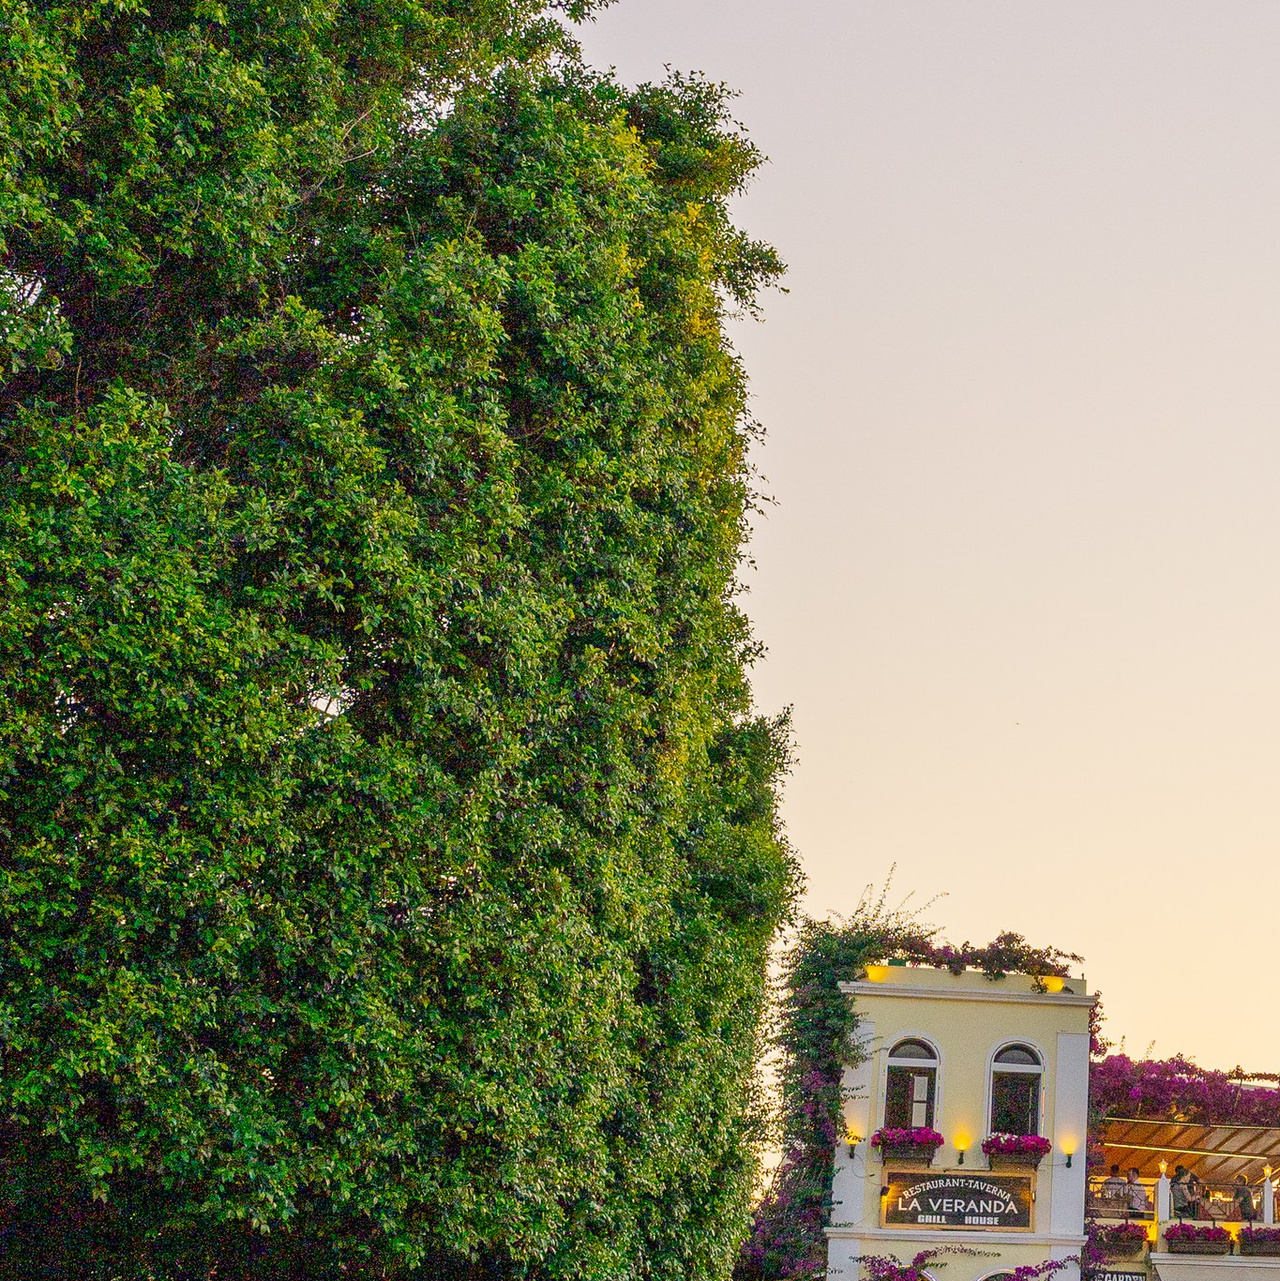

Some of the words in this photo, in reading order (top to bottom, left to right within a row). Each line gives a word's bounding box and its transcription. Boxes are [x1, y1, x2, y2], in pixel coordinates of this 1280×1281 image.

[902, 1179, 1011, 1202] RESTAURANT-TAVERNA
[897, 1197, 921, 1211] LA
[928, 1198, 1018, 1214] VERANDA
[917, 1214, 947, 1224] GRILL
[964, 1216, 999, 1225] HOUSE
